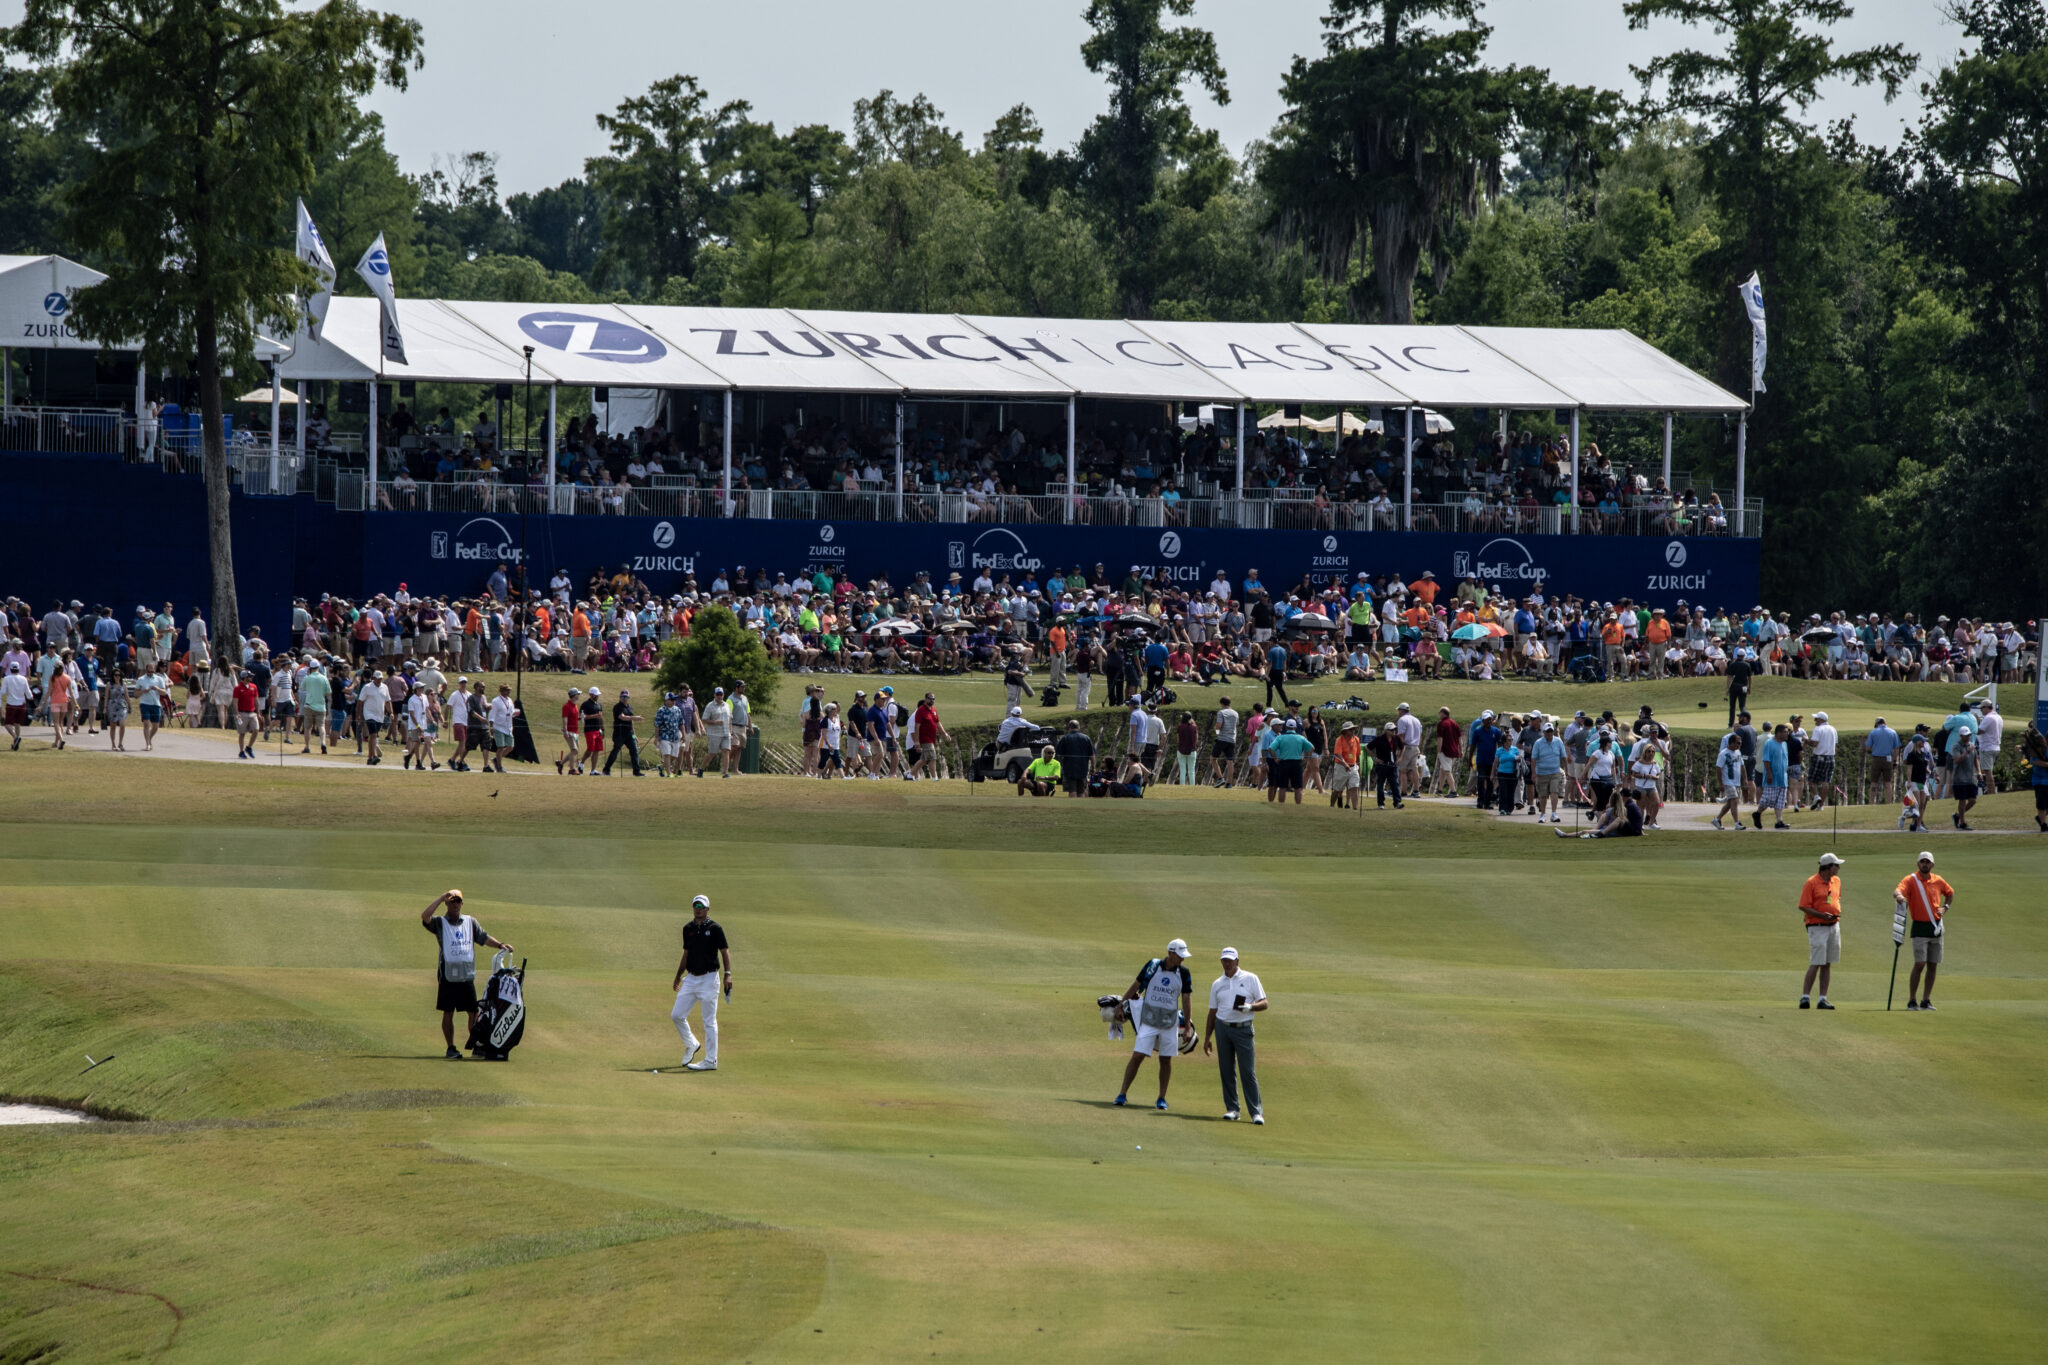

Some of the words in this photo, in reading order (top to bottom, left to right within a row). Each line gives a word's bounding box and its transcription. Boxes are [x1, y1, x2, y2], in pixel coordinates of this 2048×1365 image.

[24, 323, 79, 338] ZURIC
[689, 328, 1073, 364] ZURICH
[1115, 340, 1470, 374] CLASSIC
[808, 545, 846, 556] ZURICH
[632, 556, 695, 571] ZURICH
[808, 563, 845, 574] CLASIC
[972, 552, 1042, 573] FedExCup
[1312, 556, 1349, 566] ZURICH
[1311, 573, 1349, 584] CLAIC
[1477, 561, 1547, 584] FedExCup
[1647, 575, 1706, 590] ZURICH
